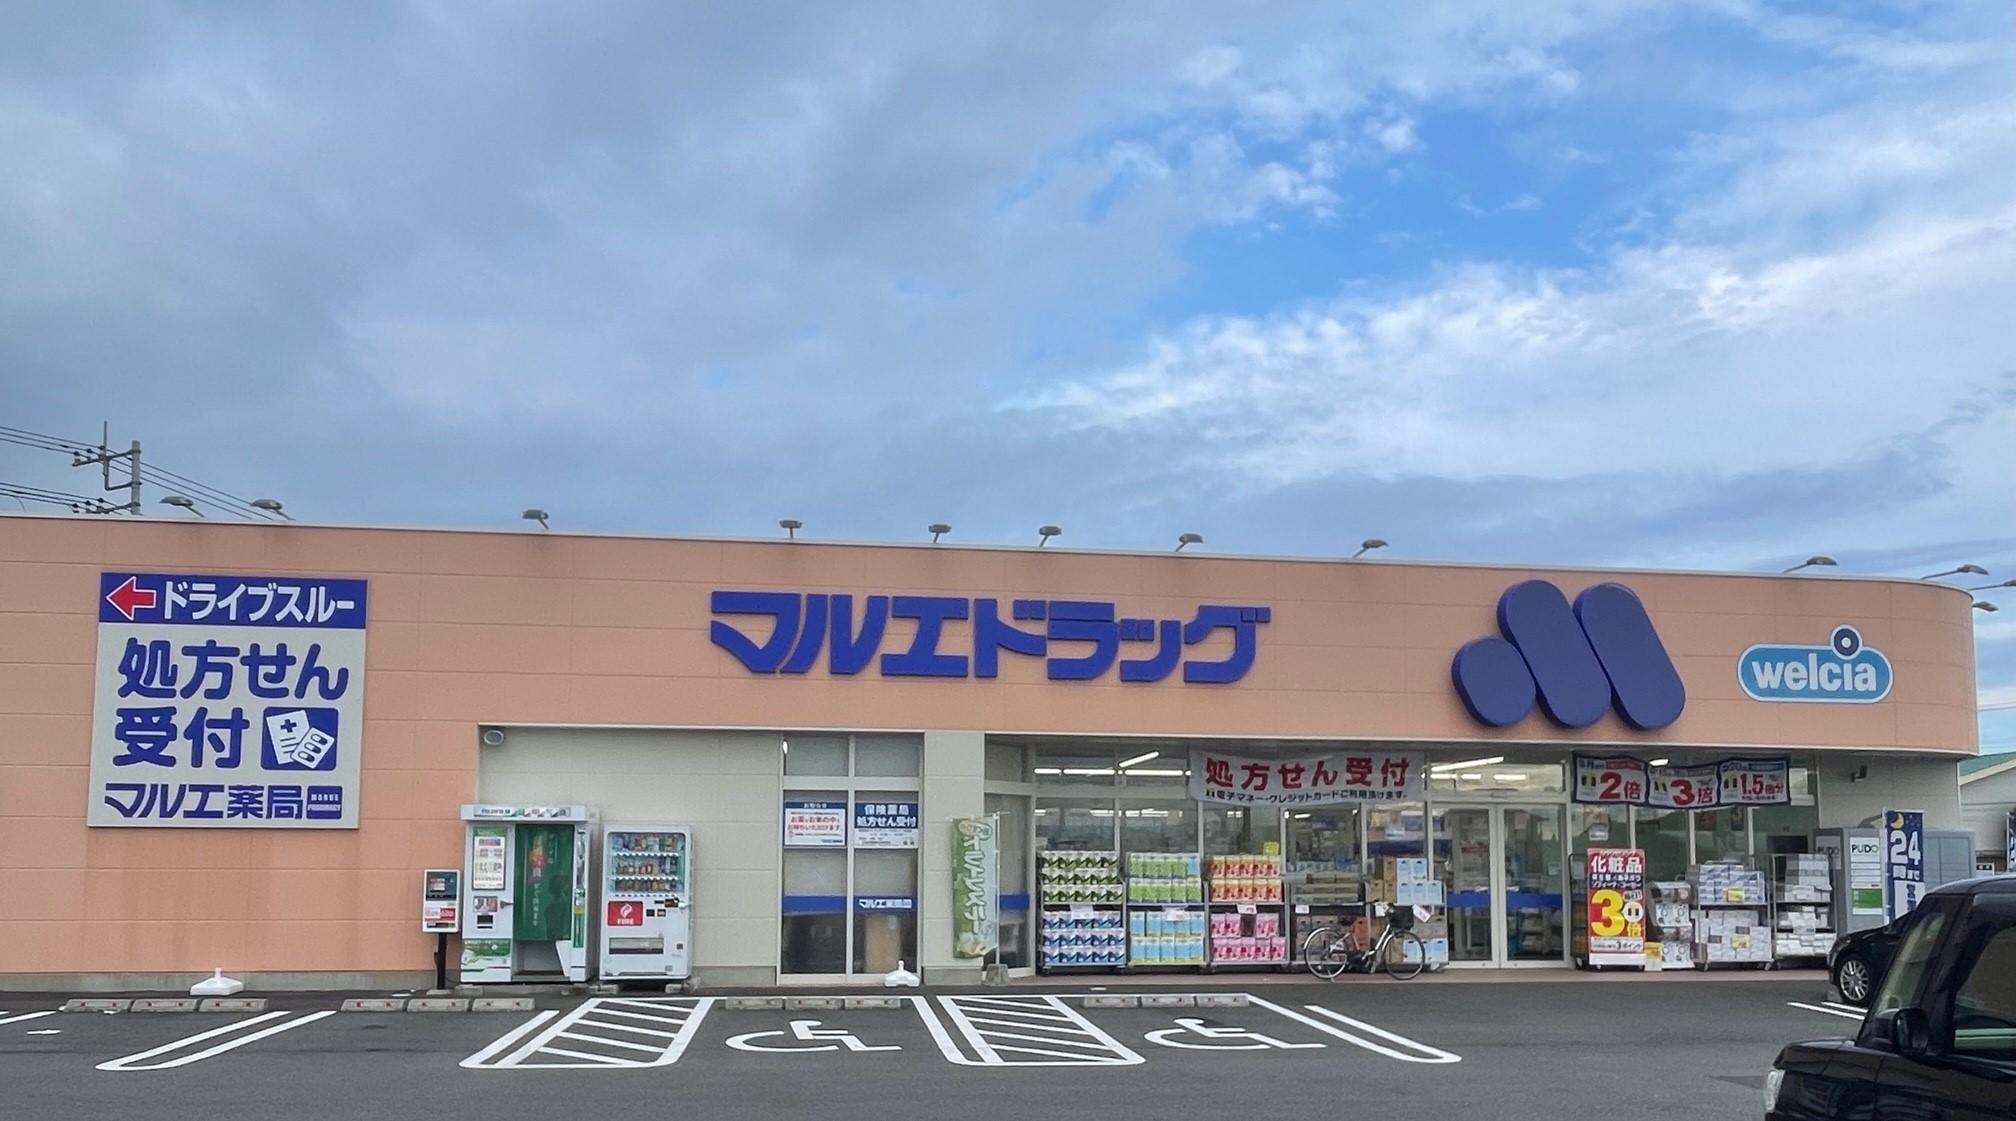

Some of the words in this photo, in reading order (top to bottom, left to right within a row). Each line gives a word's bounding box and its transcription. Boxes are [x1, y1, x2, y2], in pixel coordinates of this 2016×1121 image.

[164, 580, 354, 623] ドライブスルー
[710, 591, 1271, 683] マルエドラッグ
[117, 637, 349, 700] 処方せん
[1752, 628, 1877, 691] welcia
[113, 706, 250, 768] 受付
[1206, 757, 1409, 791] 処方せん受付
[104, 782, 303, 820] マルエ薬局
[857, 816, 917, 827] 処方せん受付
[1591, 855, 1642, 873] 化粧品
[1851, 844, 1879, 853] PUDO
[1890, 830, 1921, 865] 24
